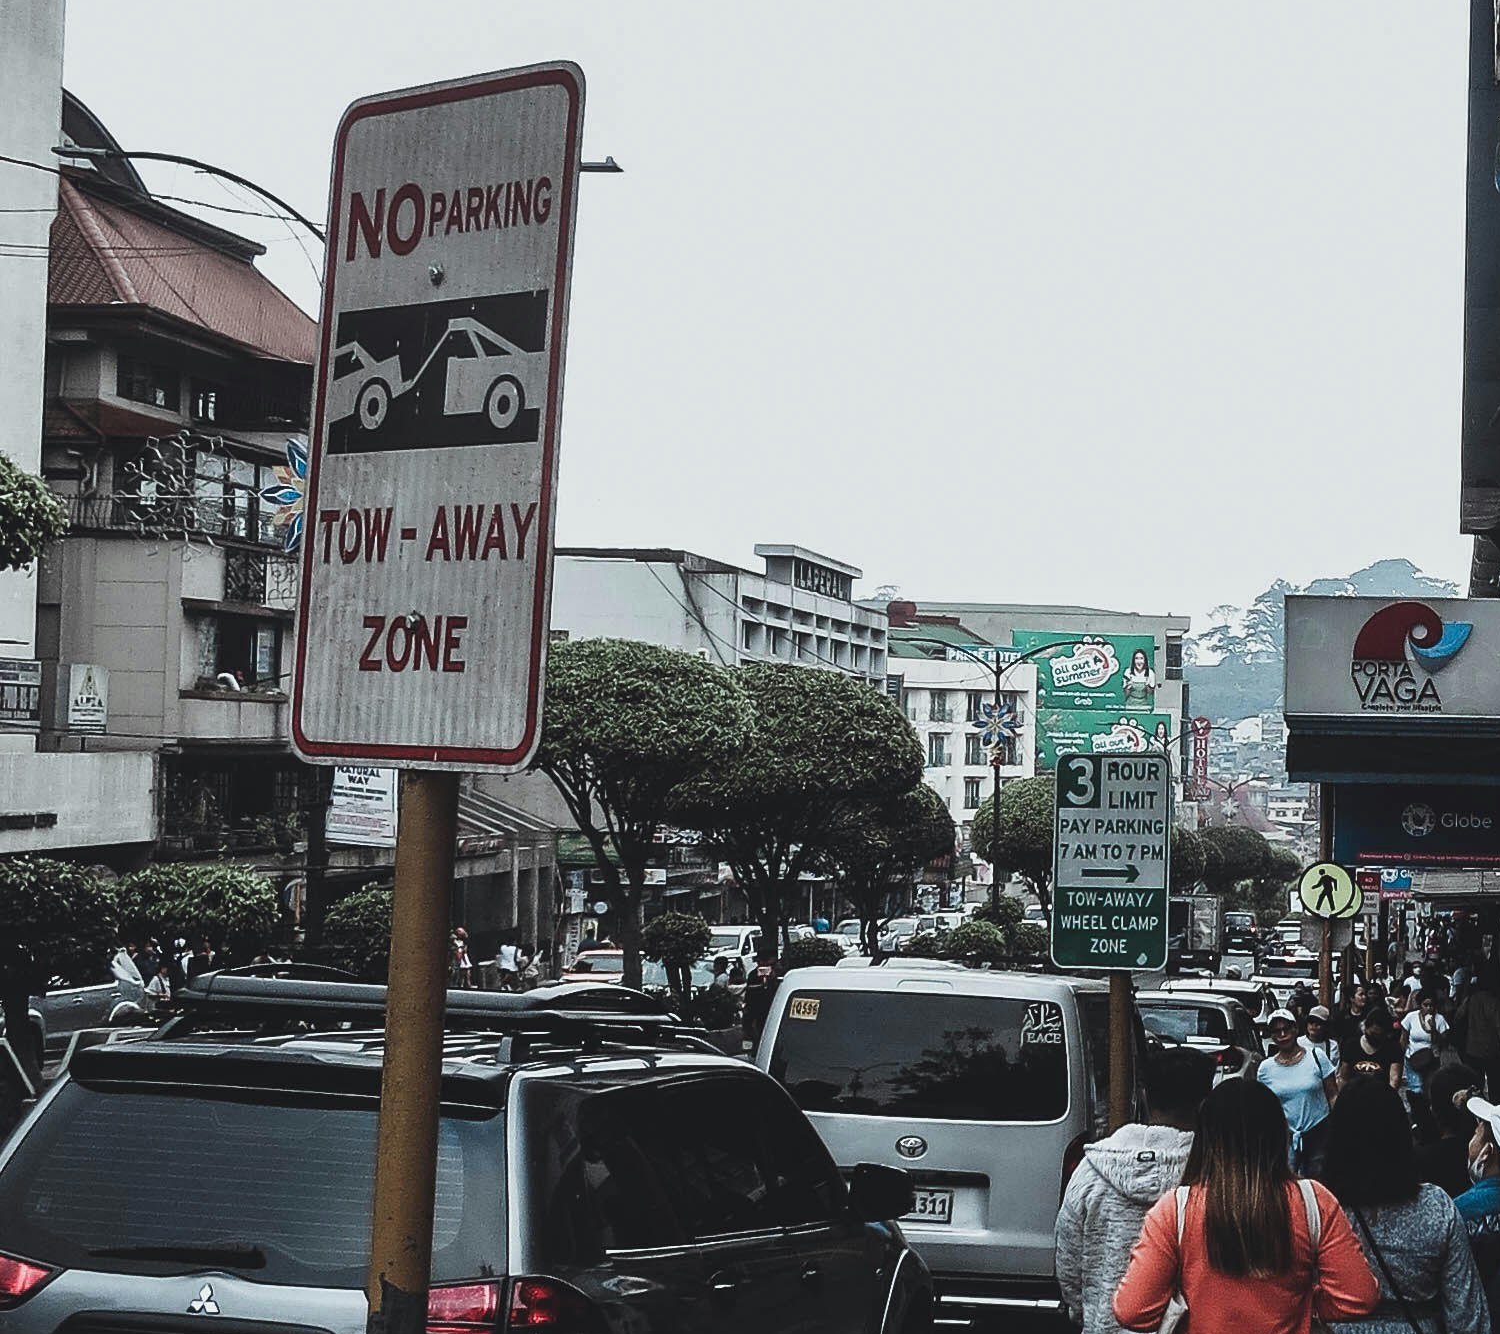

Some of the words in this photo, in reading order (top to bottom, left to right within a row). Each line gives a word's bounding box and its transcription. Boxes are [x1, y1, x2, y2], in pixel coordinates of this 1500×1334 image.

[345, 182, 425, 261] NO
[428, 177, 551, 235] PARKING
[359, 615, 468, 673] ZONE
[1055, 665, 1069, 675] all
[1072, 660, 1091, 671] out
[1056, 669, 1101, 684] summer
[1350, 660, 1414, 677] PORTA
[1351, 676, 1442, 704] VAGA
[1107, 762, 1160, 781] HOUR
[1066, 757, 1095, 805] 3
[1108, 791, 1157, 810] LIMIT
[1060, 819, 1090, 835] PAY
[1094, 818, 1164, 836] PARKING
[1441, 812, 1492, 828] Globe
[1060, 843, 1069, 860] 7
[1073, 844, 1096, 860] AM
[1103, 844, 1122, 860] TO
[1126, 844, 1136, 860] 7
[1140, 844, 1164, 861] PM
[1060, 914, 1105, 931] WHEEL
[1111, 915, 1159, 931] CLAMP
[1090, 938, 1128, 954] ZONE
[909, 1197, 947, 1215] 311
